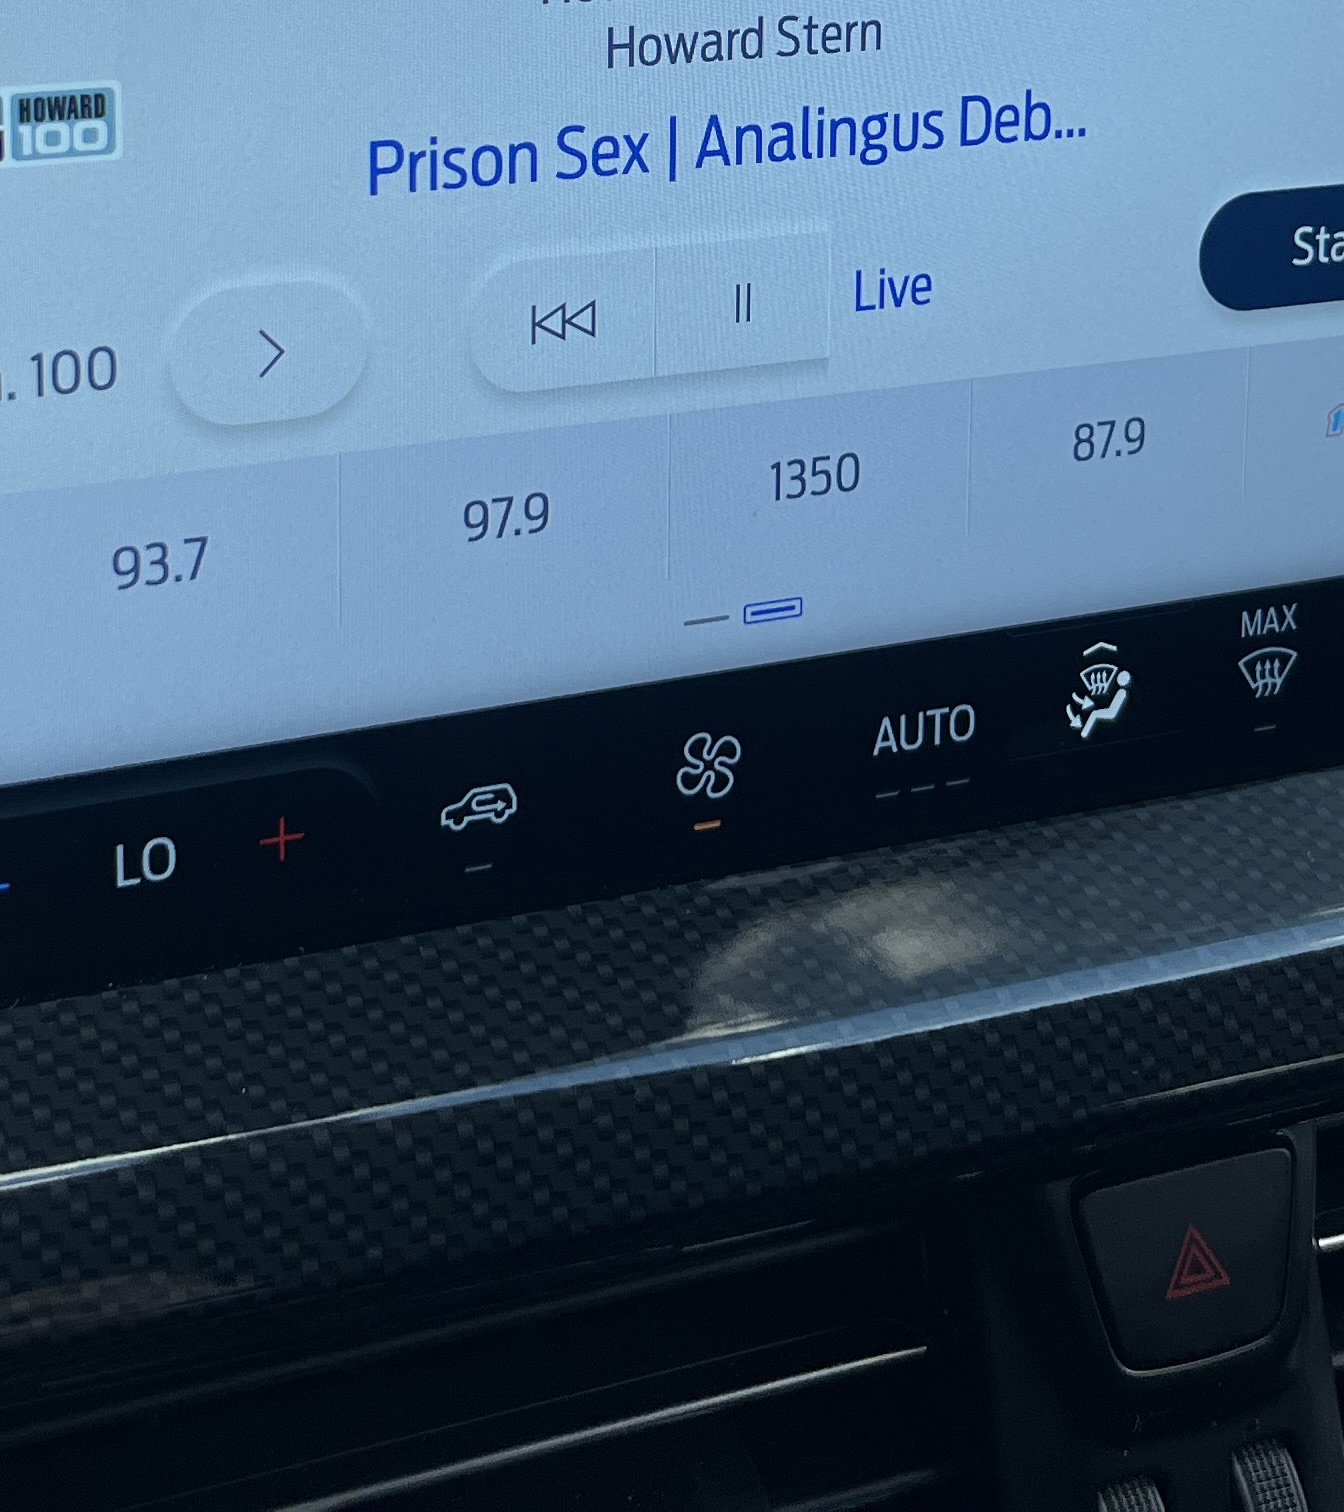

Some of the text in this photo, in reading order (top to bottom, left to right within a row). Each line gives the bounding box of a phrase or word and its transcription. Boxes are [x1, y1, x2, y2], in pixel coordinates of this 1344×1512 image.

[606, 16, 883, 69] Howard Stern
[19, 93, 106, 124] HOWARD
[18, 120, 108, 156] 100
[369, 137, 539, 197] Prison
[556, 125, 651, 180] Sex
[695, 105, 945, 170] Analingus
[960, 89, 1087, 147] Deb...
[855, 268, 932, 312] Live
[1072, 416, 1146, 462] 87.9
[769, 451, 860, 502] 1350
[462, 492, 550, 542] 97.9
[112, 536, 209, 590] 93.7
[1240, 604, 1299, 638] MAX
[873, 704, 976, 758] AUTO
[114, 836, 176, 888] LO
